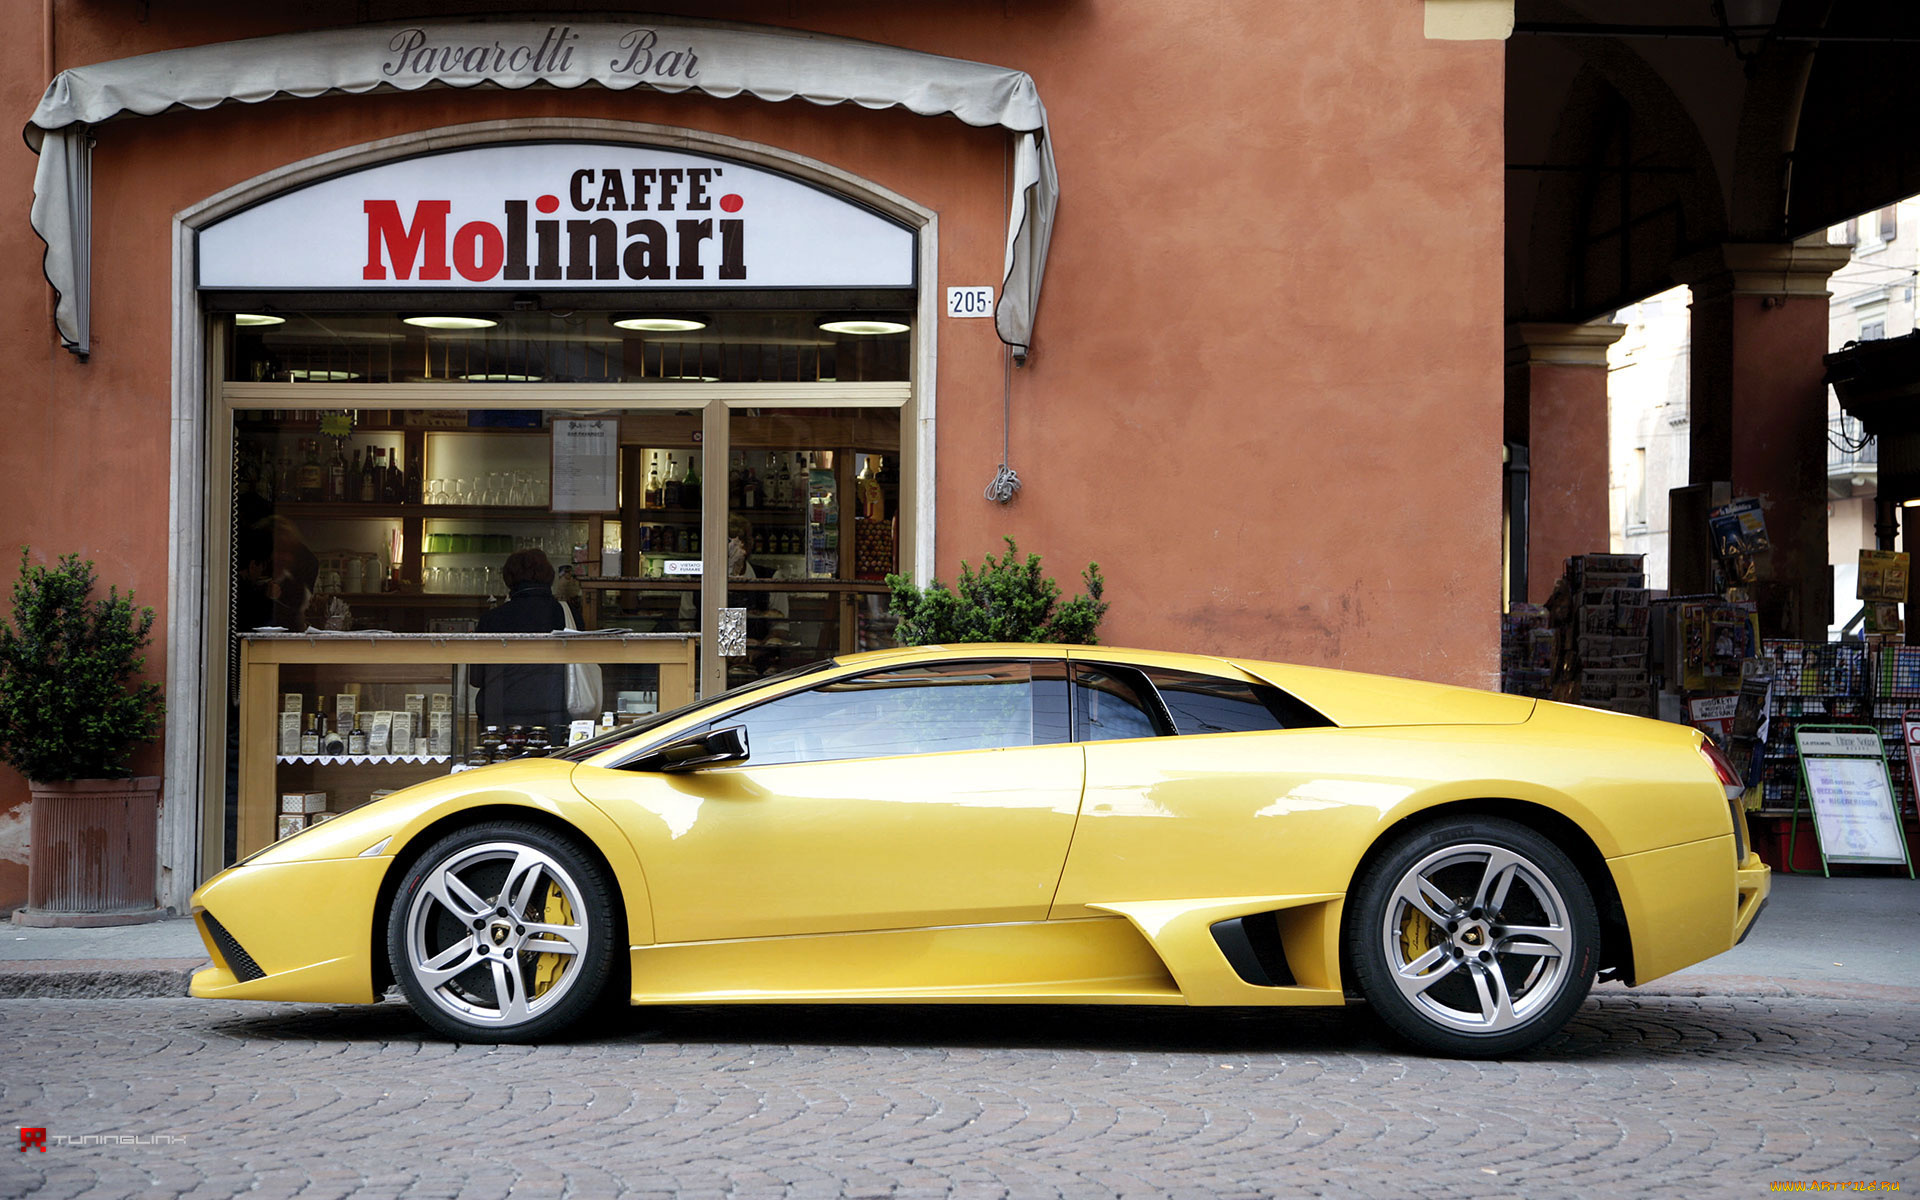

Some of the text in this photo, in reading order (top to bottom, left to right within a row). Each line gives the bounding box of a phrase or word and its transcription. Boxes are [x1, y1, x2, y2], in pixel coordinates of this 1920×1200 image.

[383, 26, 700, 80] Pavarotti Bar
[363, 193, 747, 282] Molinari
[953, 291, 986, 313] 205
